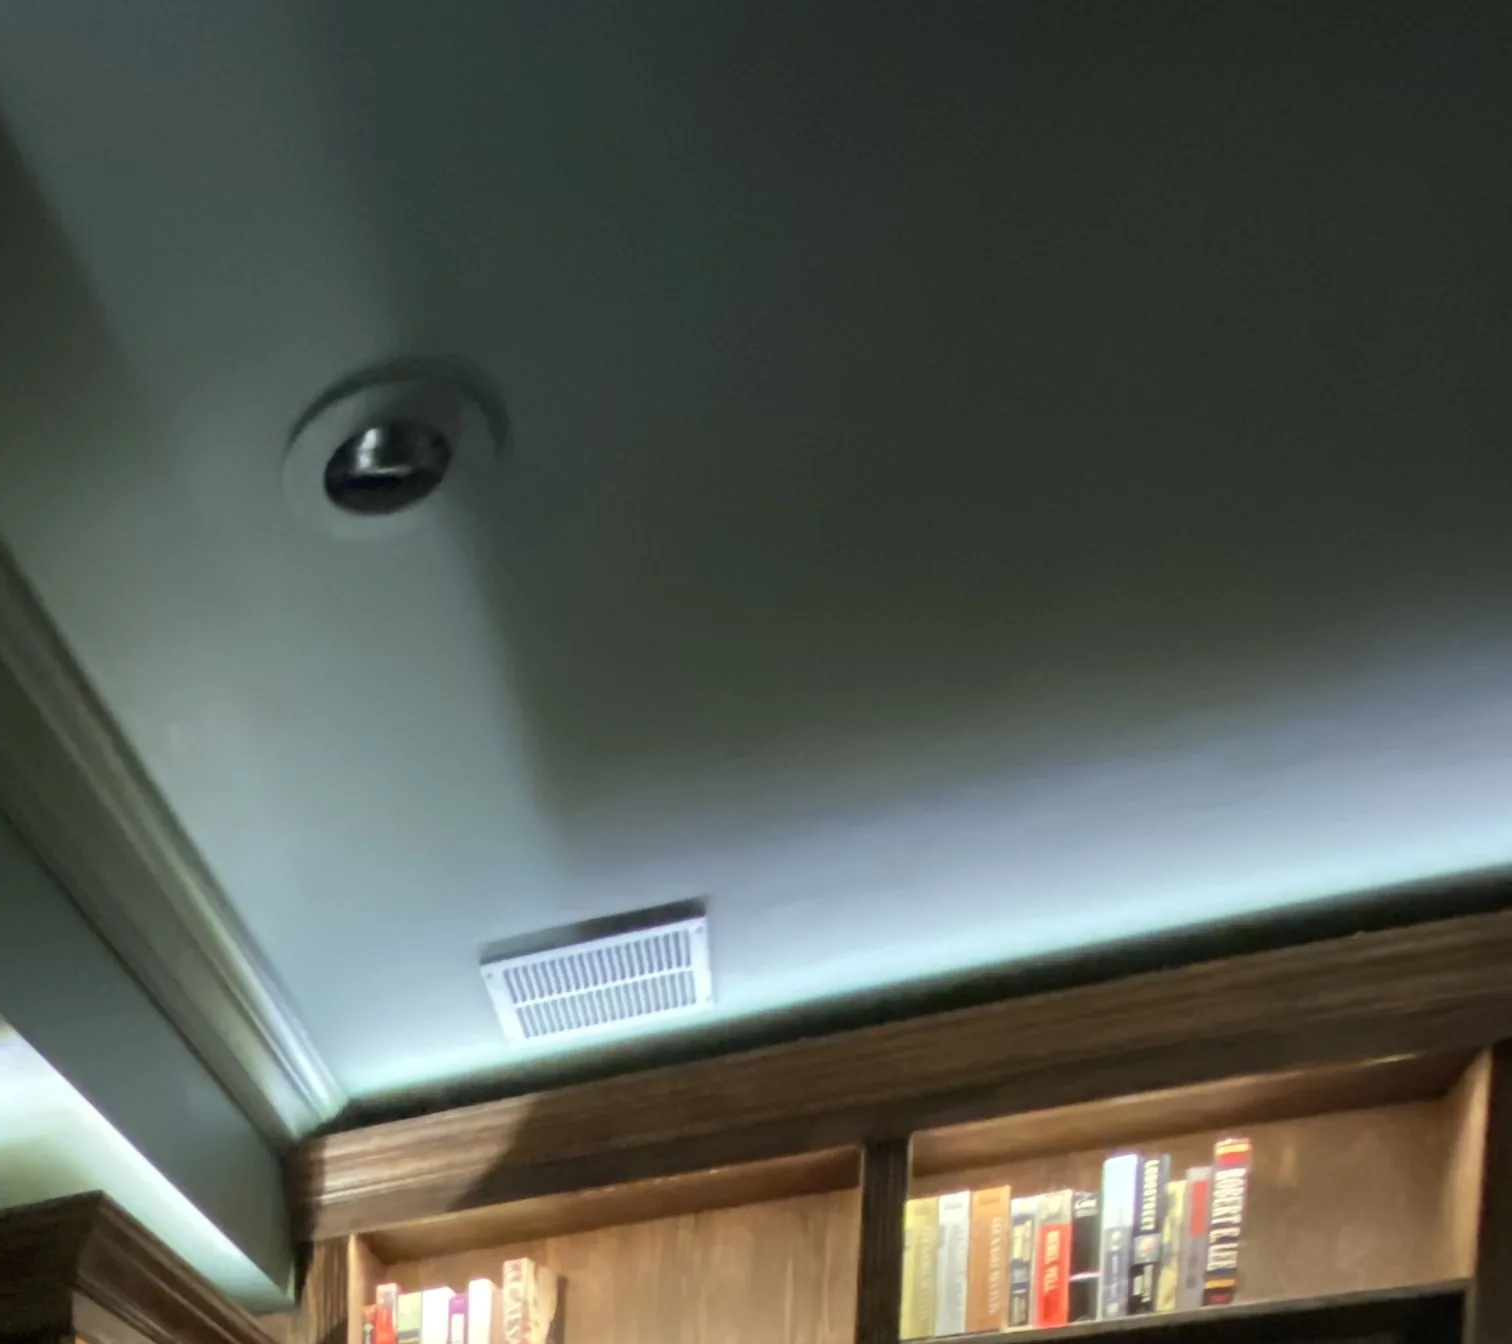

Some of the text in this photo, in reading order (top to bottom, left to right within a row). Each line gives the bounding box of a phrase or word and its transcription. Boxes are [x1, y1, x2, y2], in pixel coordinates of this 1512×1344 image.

[1206, 1167, 1246, 1272] ROBERT E. LEE
